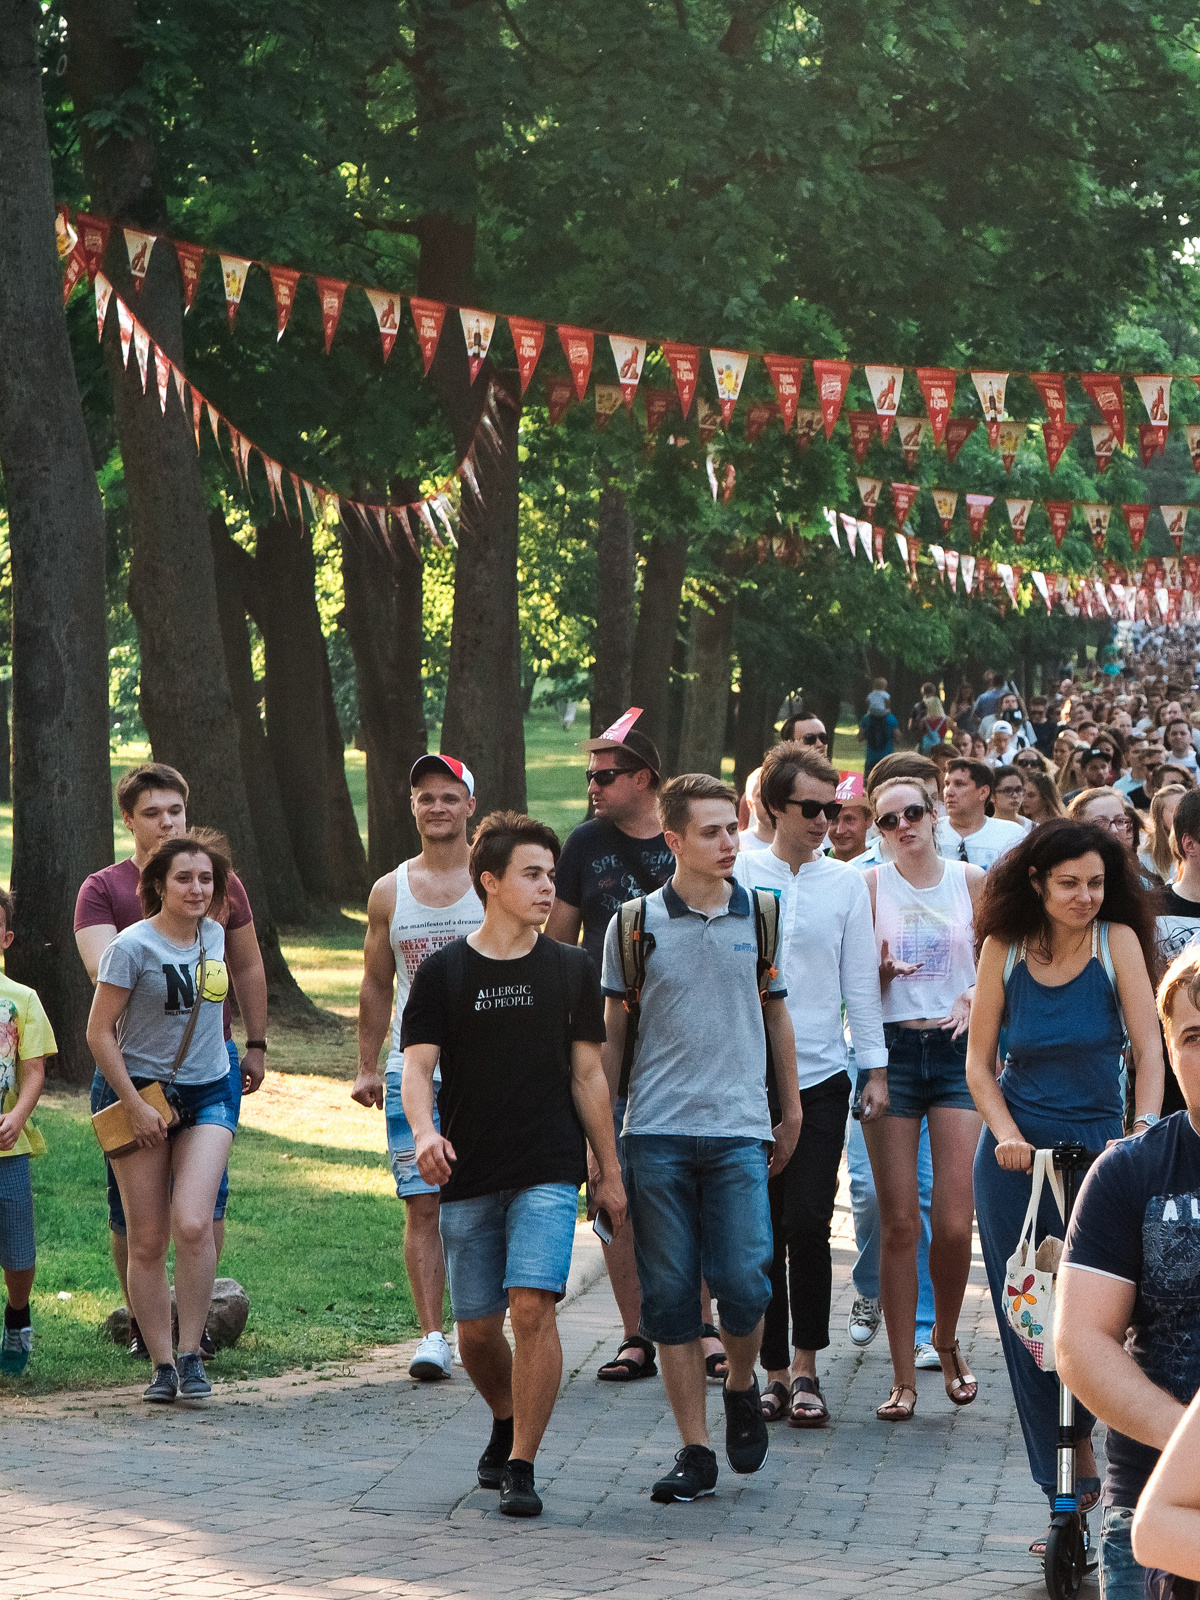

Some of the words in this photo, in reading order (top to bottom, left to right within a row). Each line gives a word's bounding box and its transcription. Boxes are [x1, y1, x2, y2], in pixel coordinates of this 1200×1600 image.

[410, 920, 443, 930] manifesto
[477, 984, 531, 1000] ALLERGIC
[474, 1000, 492, 1011] TO
[494, 996, 534, 1009] PEOPLE
